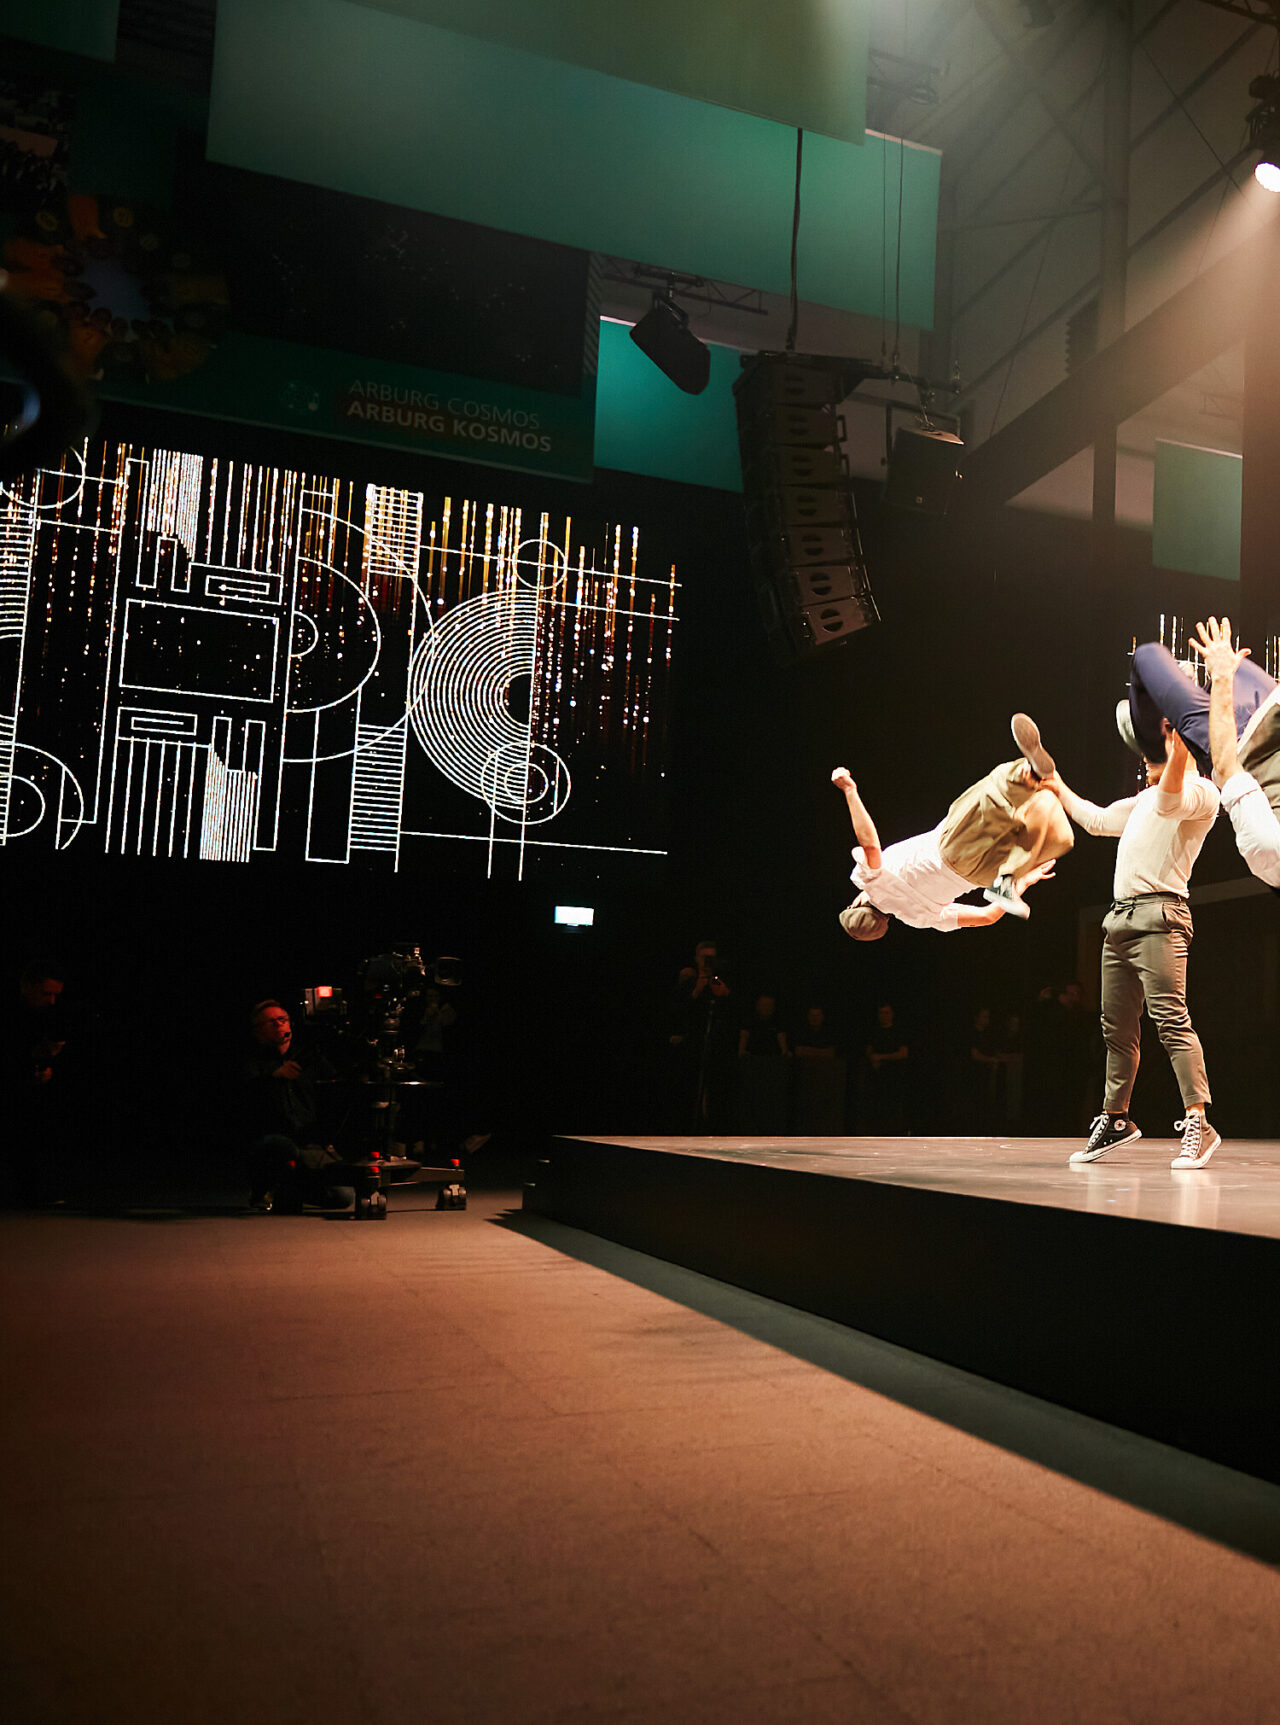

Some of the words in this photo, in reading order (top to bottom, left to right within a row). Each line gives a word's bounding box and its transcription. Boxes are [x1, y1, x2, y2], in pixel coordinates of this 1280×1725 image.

[347, 400, 444, 433] ARBURG
[452, 419, 552, 452] KOSMOS
[349, 379, 439, 411] ARBURG
[447, 397, 540, 429] COSMOS
